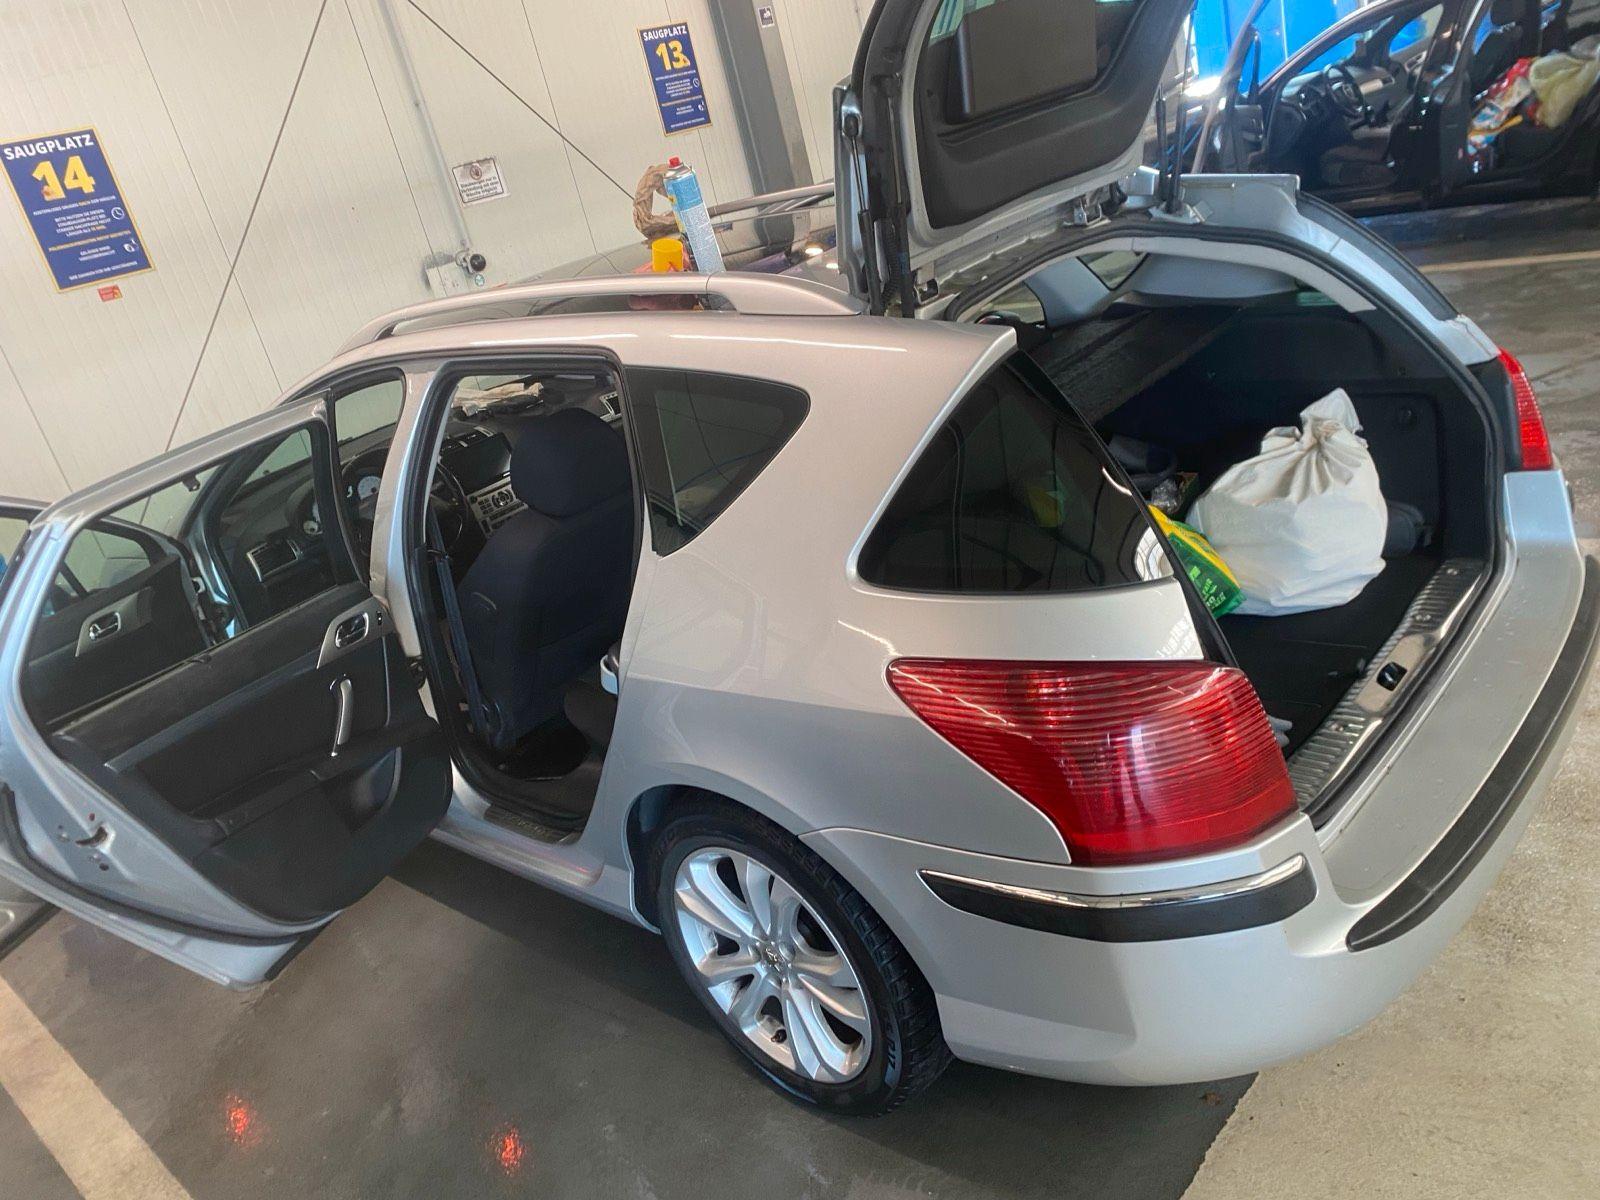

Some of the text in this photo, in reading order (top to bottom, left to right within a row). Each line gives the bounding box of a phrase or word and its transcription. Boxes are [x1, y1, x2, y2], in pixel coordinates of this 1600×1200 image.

[643, 25, 687, 41] SAUGPLATZ
[656, 40, 691, 71] 13
[4, 134, 94, 160] SAUGPLATZ
[32, 155, 95, 201] 14
